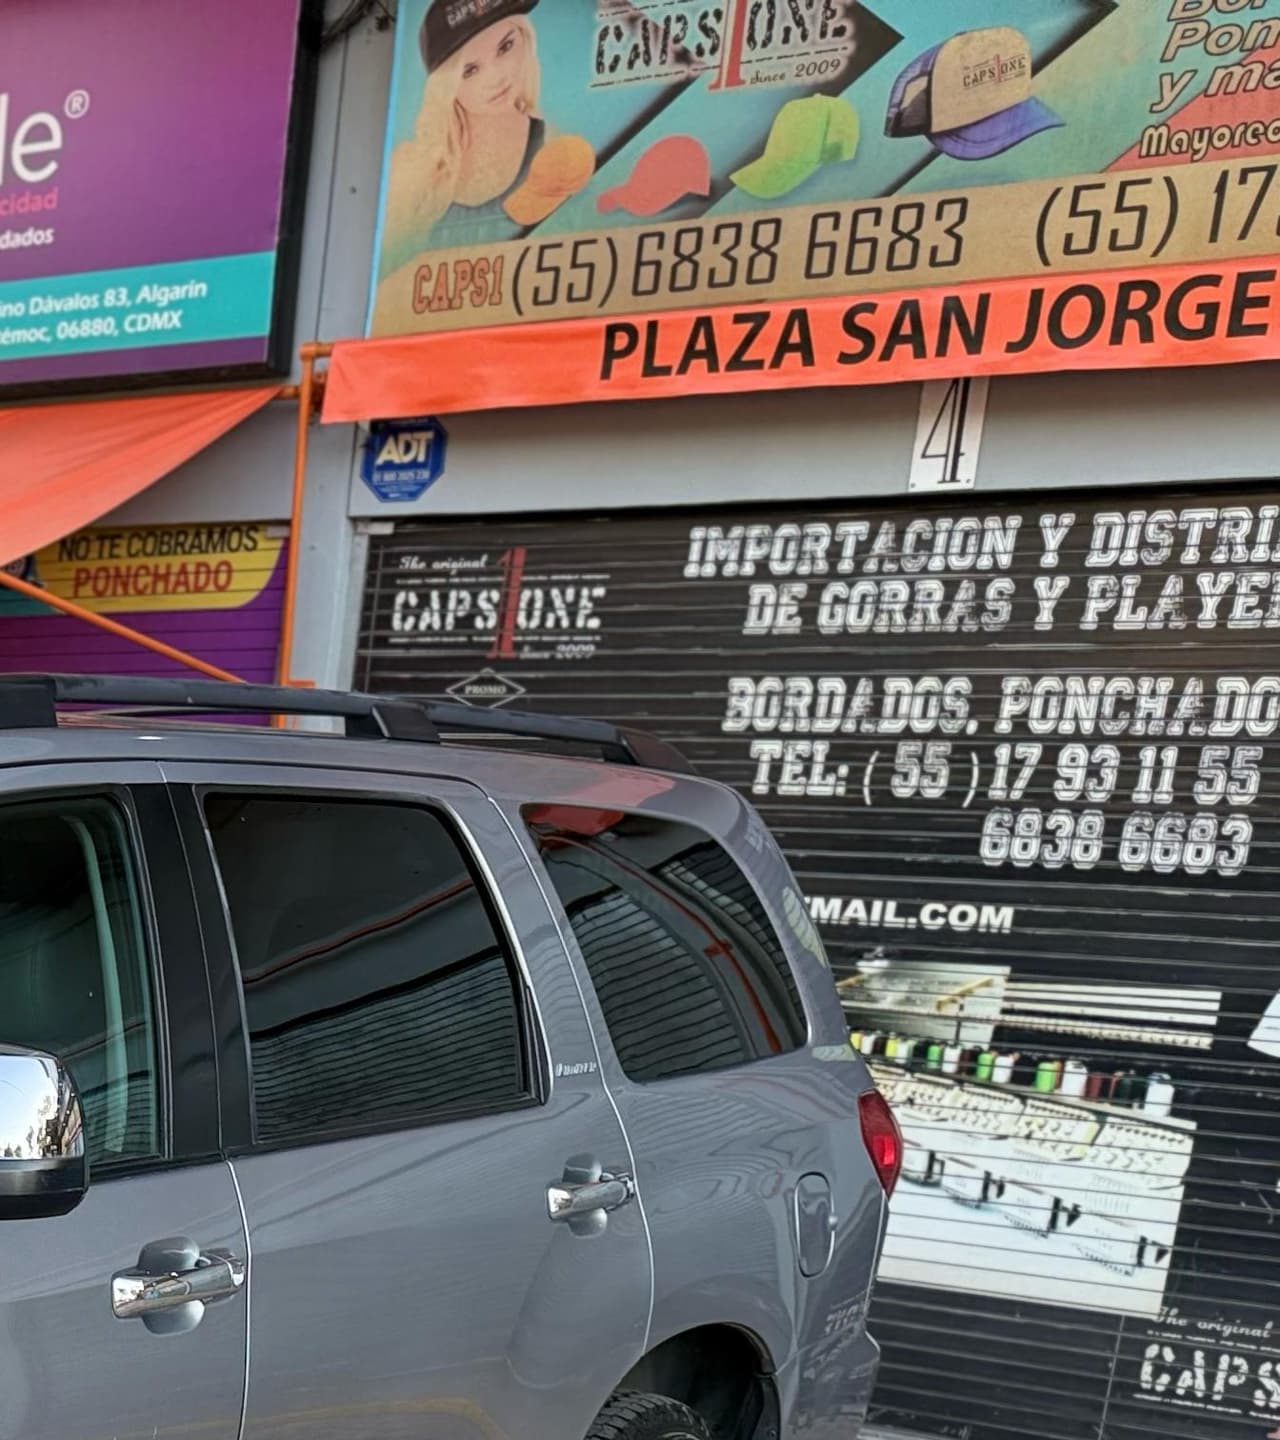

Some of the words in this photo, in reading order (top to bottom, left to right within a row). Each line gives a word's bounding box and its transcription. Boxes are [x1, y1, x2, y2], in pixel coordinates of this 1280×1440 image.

[793, 57, 841, 78] 2009
[1149, 69, 1199, 114] y
[803, 197, 968, 281] 6683
[103, 286, 132, 309] 83,
[56, 315, 120, 340] 06880,
[123, 309, 183, 334] CDMX
[600, 307, 816, 381] PLAZA
[837, 293, 992, 365] SAN
[1005, 270, 1278, 354] JORGE
[375, 431, 435, 465] ADT
[58, 534, 91, 563] NO
[96, 533, 122, 559] TE
[127, 524, 260, 558] COBRAMOS
[683, 515, 1023, 578] IMPORTACION
[1039, 513, 1076, 568] Y
[1085, 505, 1280, 567] DISTRI
[72, 560, 234, 599] PONCHADO
[399, 555, 427, 570] The
[432, 554, 488, 575] original
[742, 582, 809, 635] DE
[817, 577, 1016, 635] GORRAS
[1034, 576, 1070, 631] Y
[465, 685, 507, 695] PROMO
[721, 676, 979, 736] BORDADOS,
[749, 739, 849, 797] TEL:
[987, 743, 1044, 801] 17
[1053, 743, 1121, 803] 93
[1132, 745, 1175, 804] 11
[1192, 745, 1264, 806] 55
[978, 806, 1105, 870] 6838
[1118, 809, 1254, 877] 6683
[804, 896, 1015, 934] MAIL.COM
[1197, 1316, 1274, 1339] original
